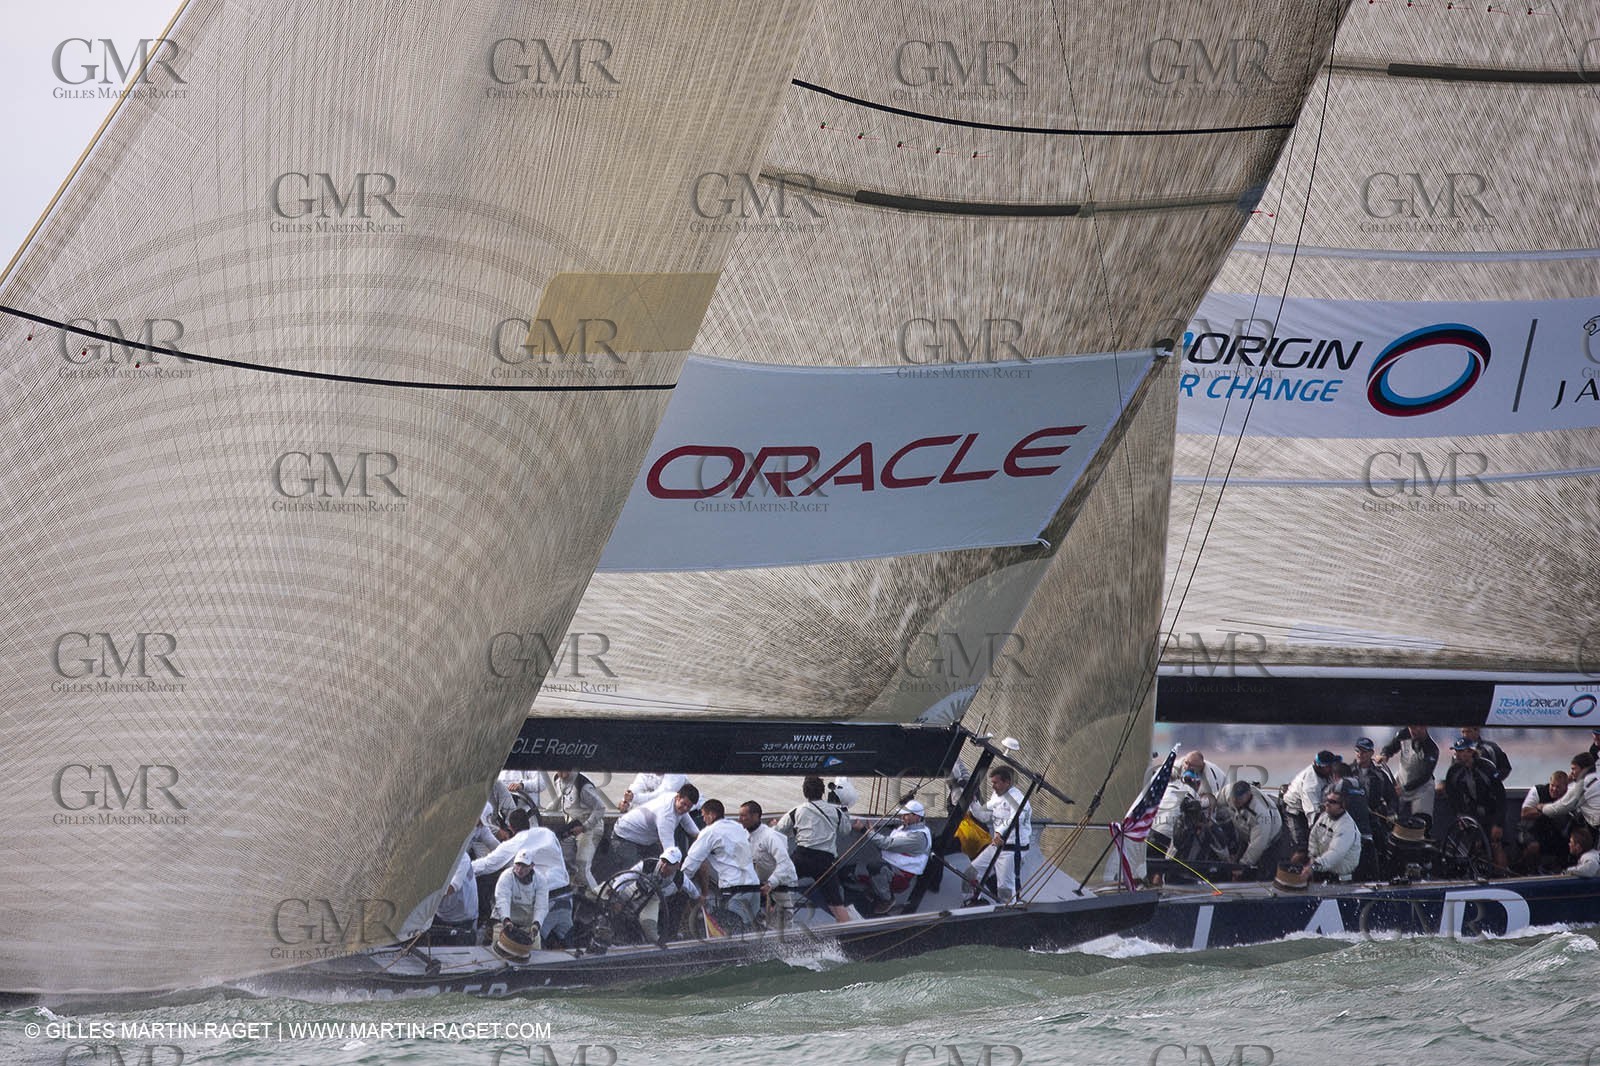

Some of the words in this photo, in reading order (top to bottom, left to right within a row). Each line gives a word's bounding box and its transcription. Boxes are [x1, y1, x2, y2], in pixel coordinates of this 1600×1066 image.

[1207, 375, 1343, 402] CHANGE
[646, 424, 1088, 499] ORACLE
[1500, 698, 1568, 707] TEAMORIGIN
[546, 738, 599, 758] Racing
